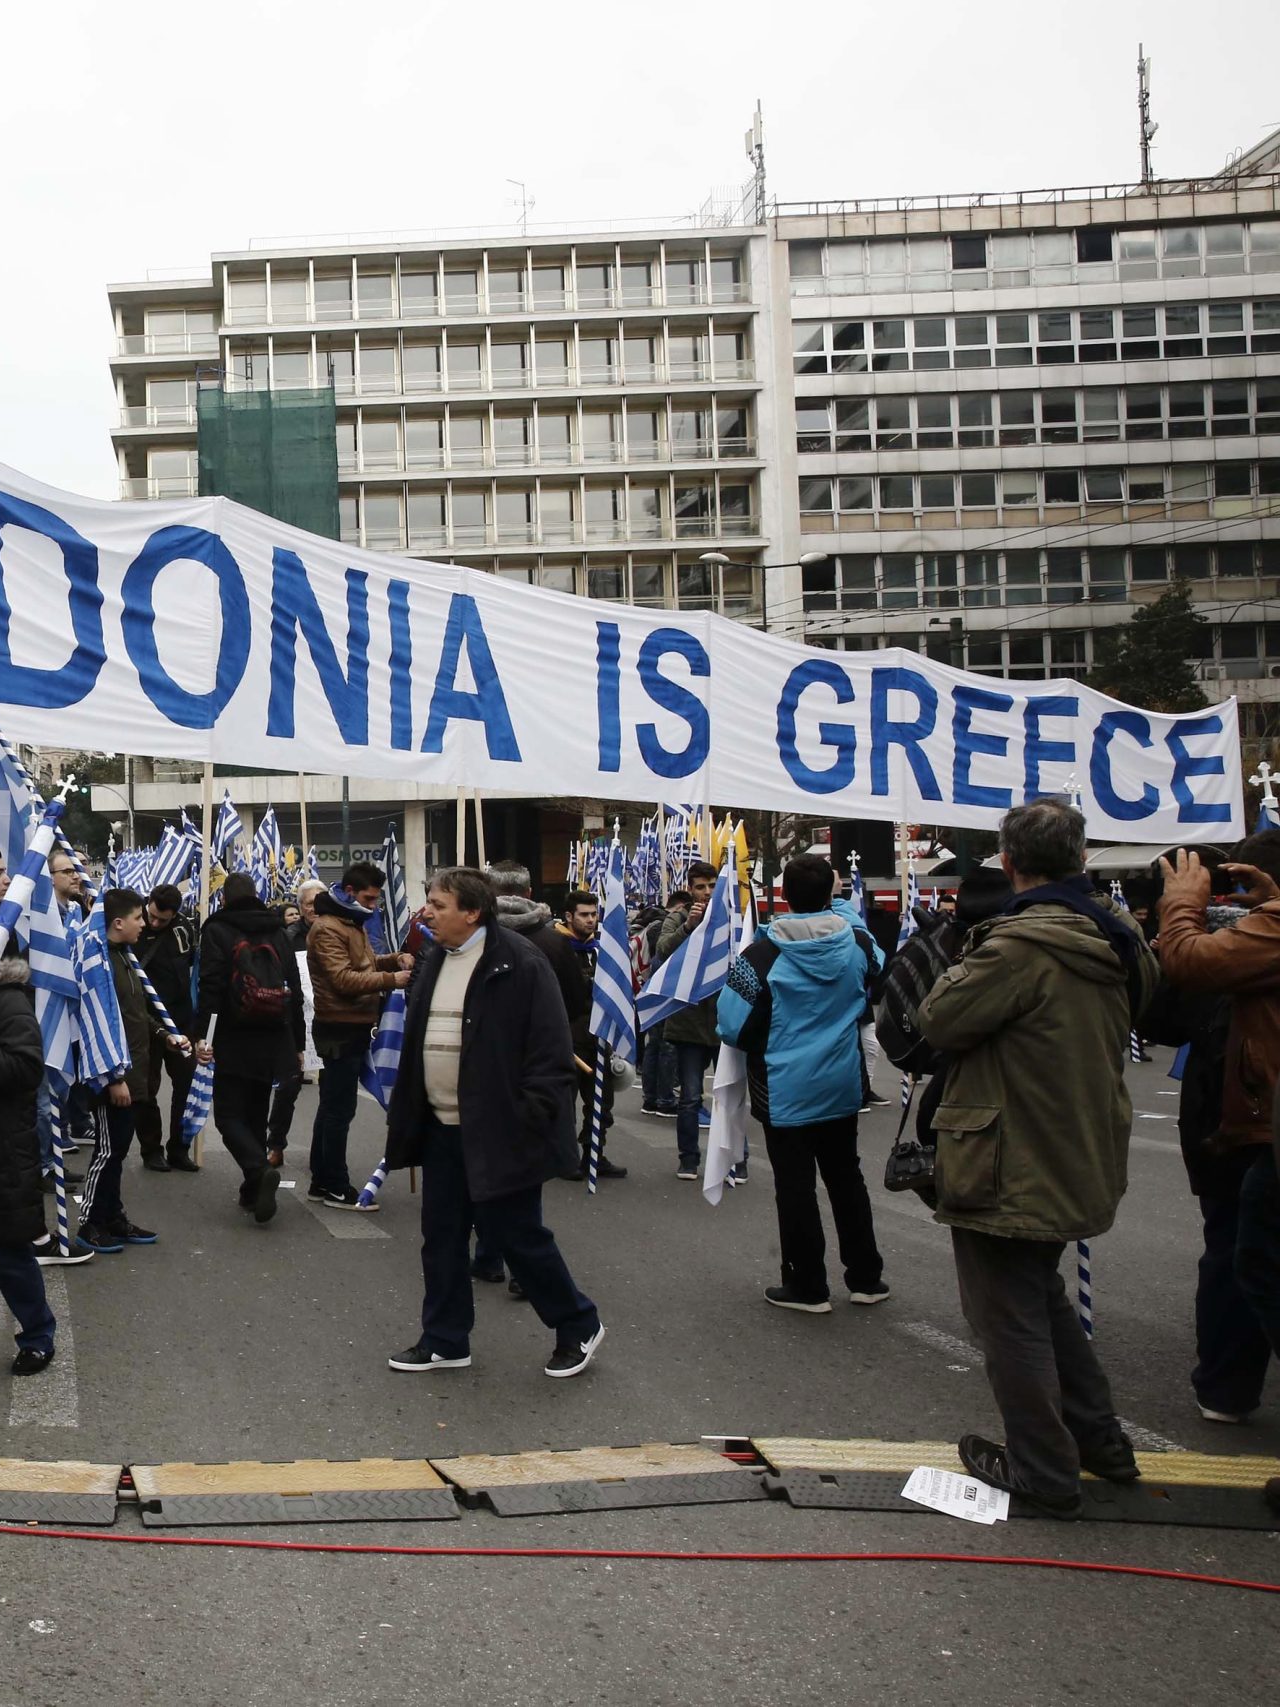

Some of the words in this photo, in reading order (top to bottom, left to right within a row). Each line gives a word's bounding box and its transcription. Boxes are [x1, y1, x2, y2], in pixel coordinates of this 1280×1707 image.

[597, 622, 711, 779] IS
[776, 658, 1232, 823] GREECE
[312, 849, 382, 862] OSOTE
